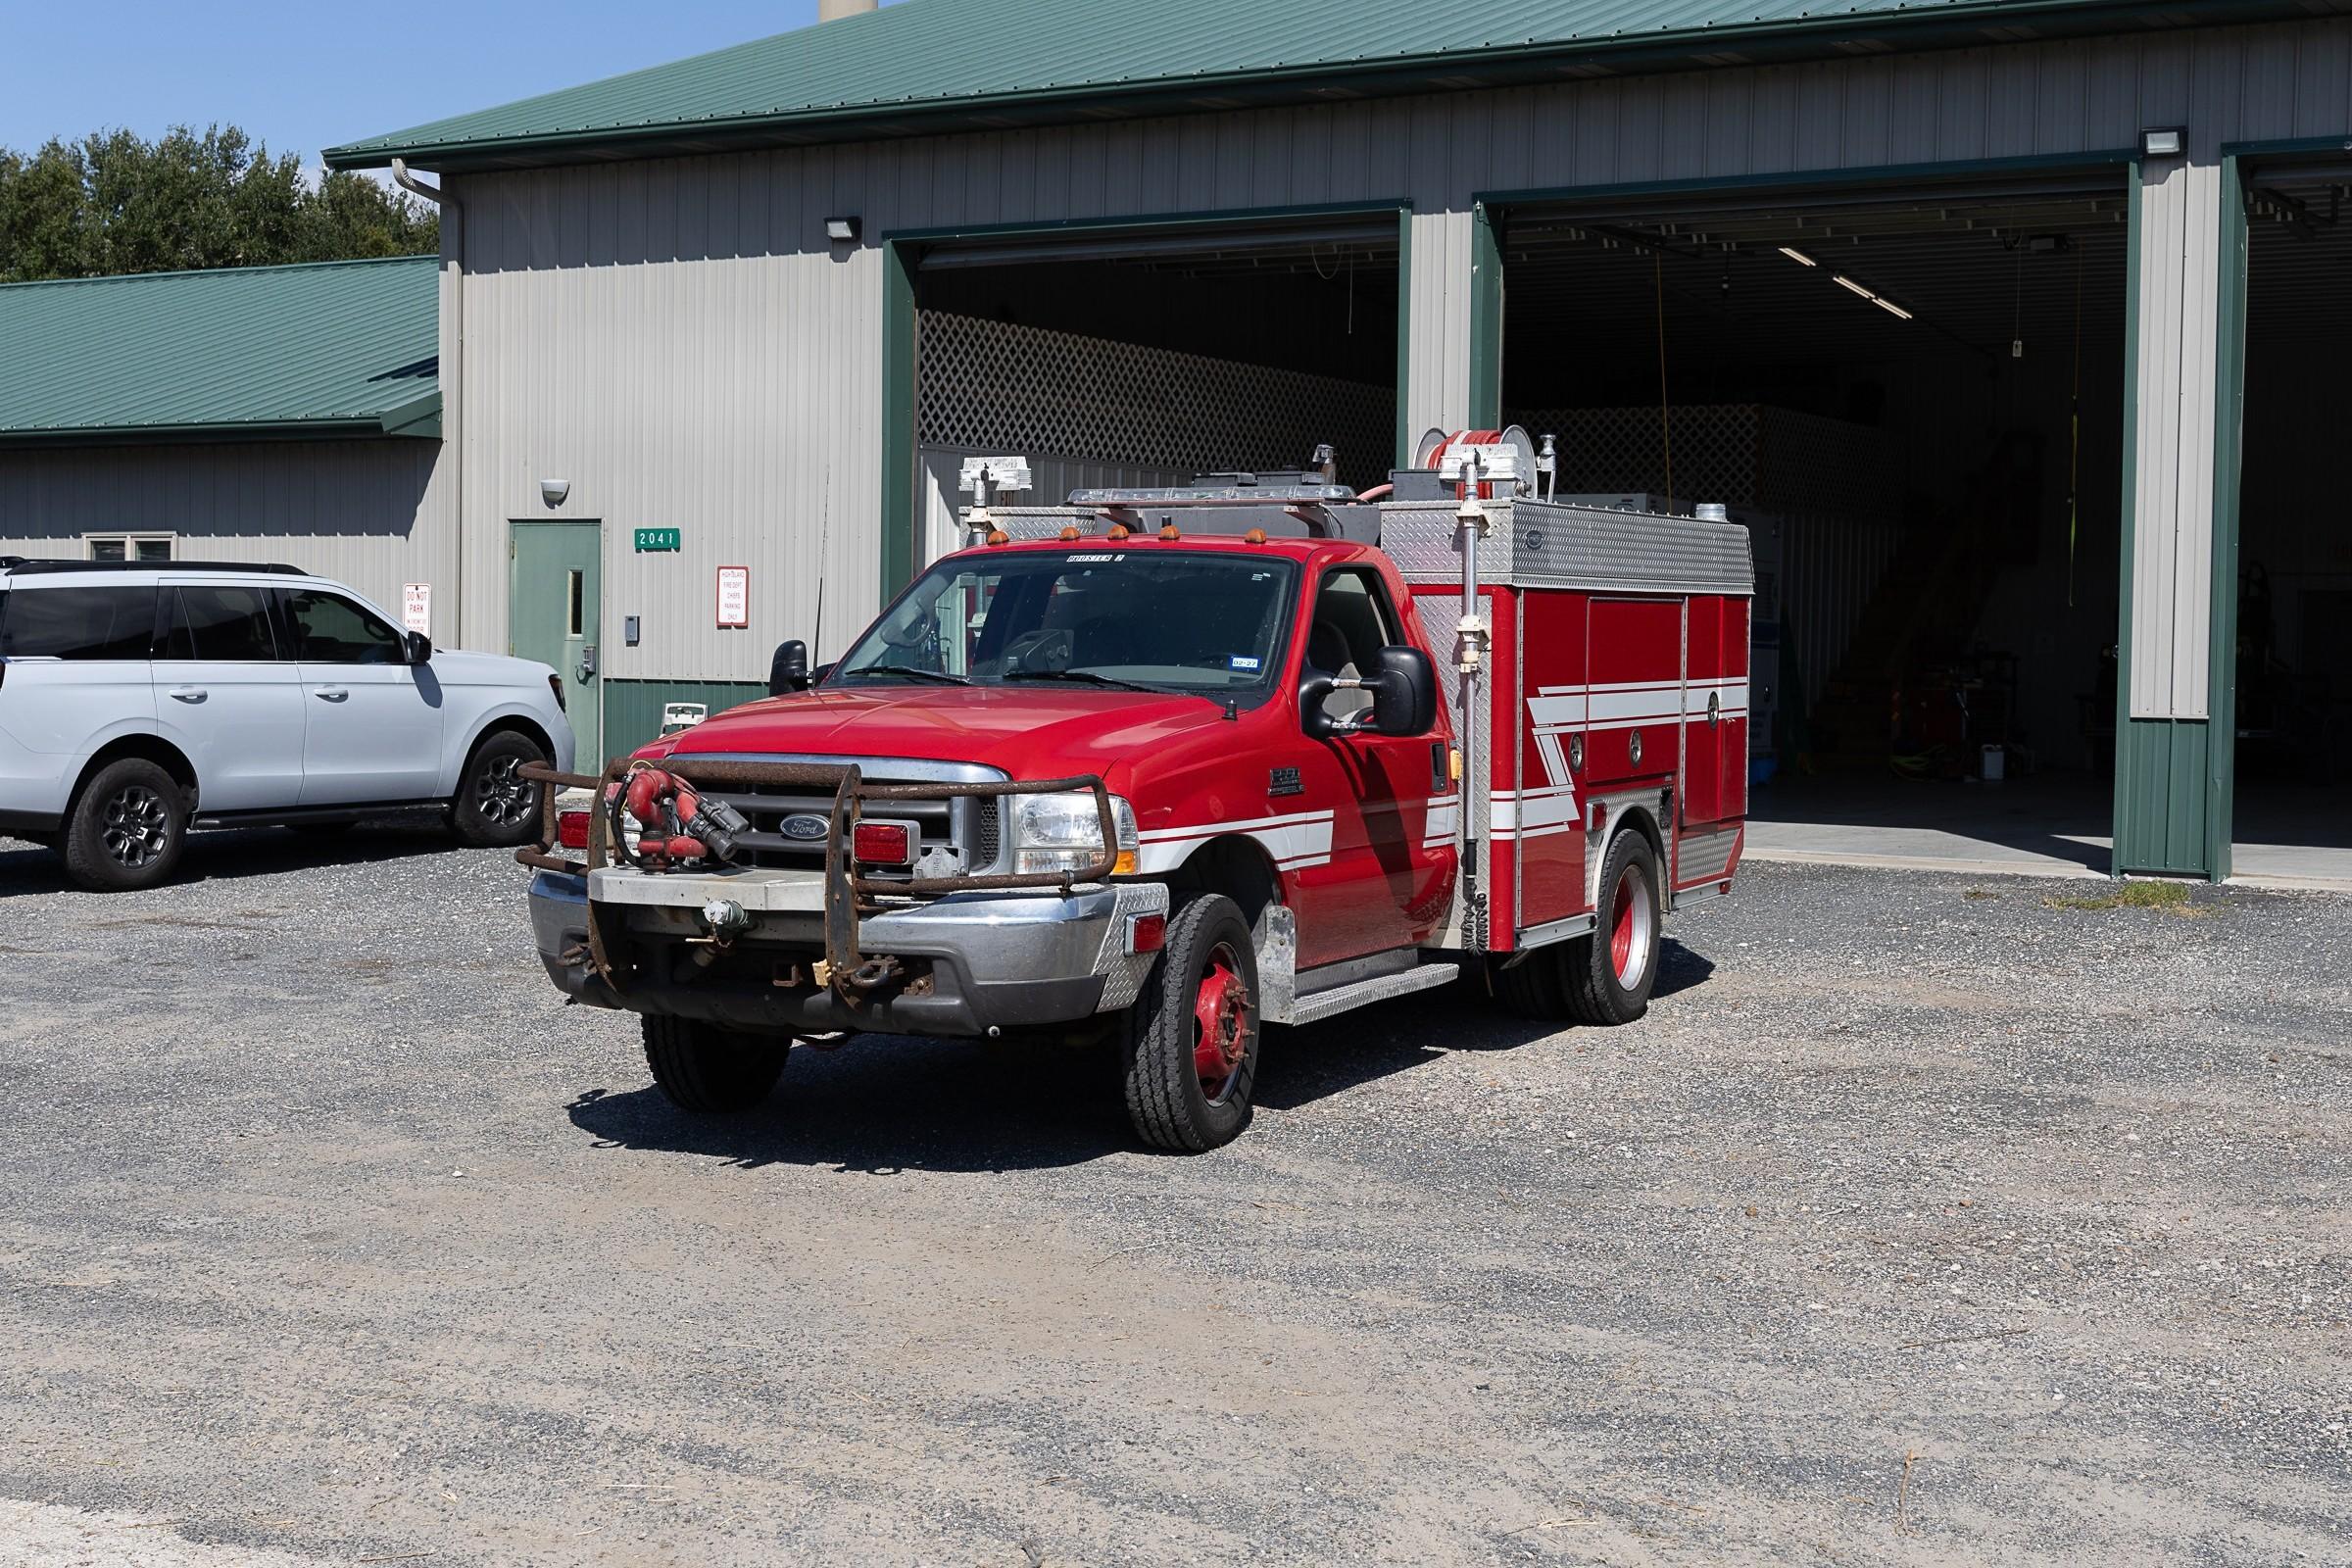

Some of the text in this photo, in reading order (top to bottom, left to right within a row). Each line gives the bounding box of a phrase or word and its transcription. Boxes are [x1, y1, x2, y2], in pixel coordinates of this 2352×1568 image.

[640, 533, 673, 545] 2041
[407, 591, 427, 601] DO NOT
[410, 604, 423, 613] PARK
[791, 819, 818, 834] Ford
